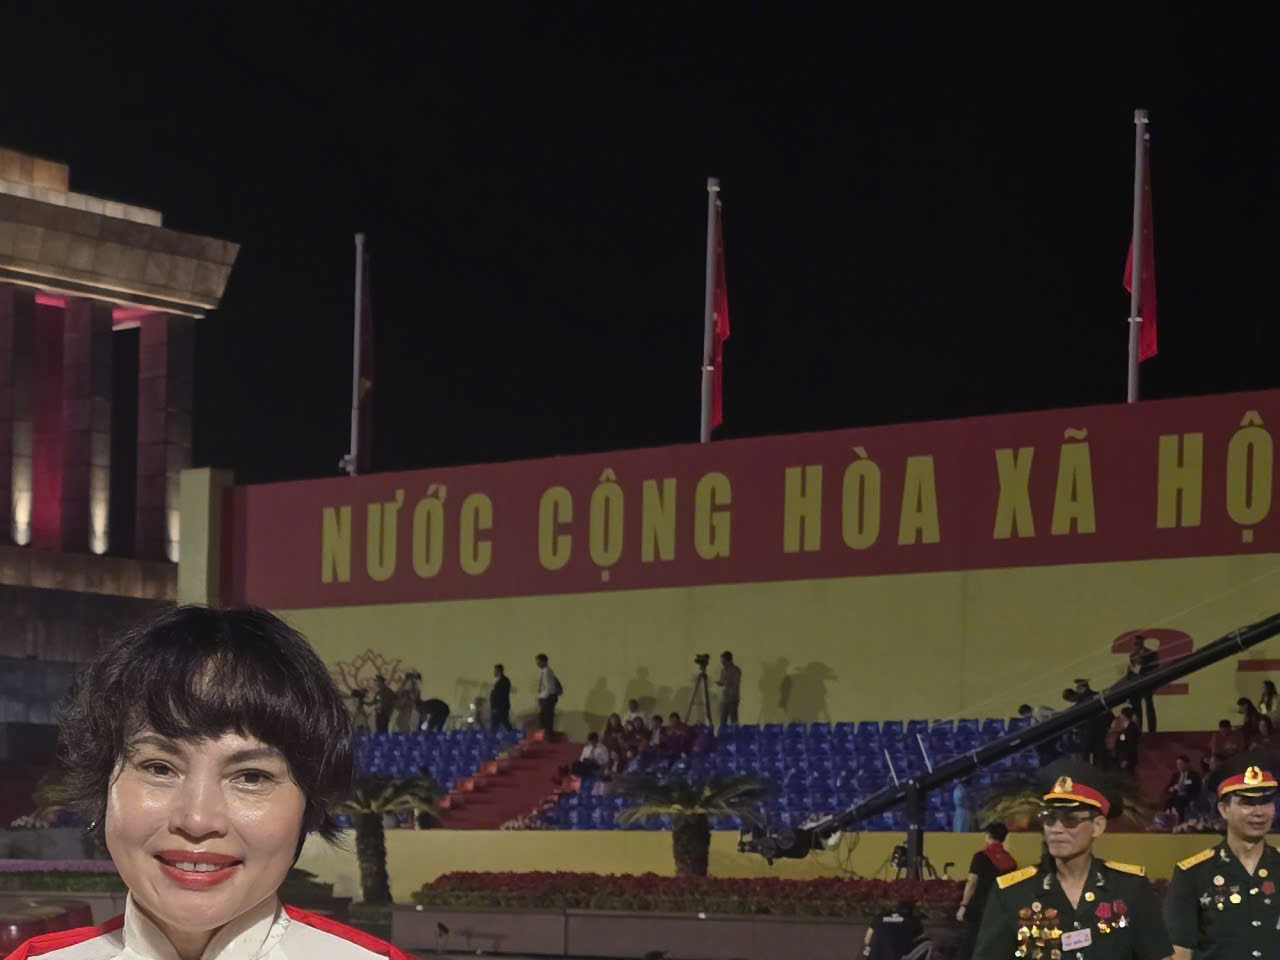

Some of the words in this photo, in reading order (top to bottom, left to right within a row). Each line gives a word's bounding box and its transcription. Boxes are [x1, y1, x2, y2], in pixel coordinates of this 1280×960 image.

[321, 484, 494, 584] NƯỚC
[537, 467, 733, 583] CỘNG
[782, 446, 941, 553] HÒA
[992, 427, 1097, 540] XÃ
[1155, 410, 1274, 543] HỘ
